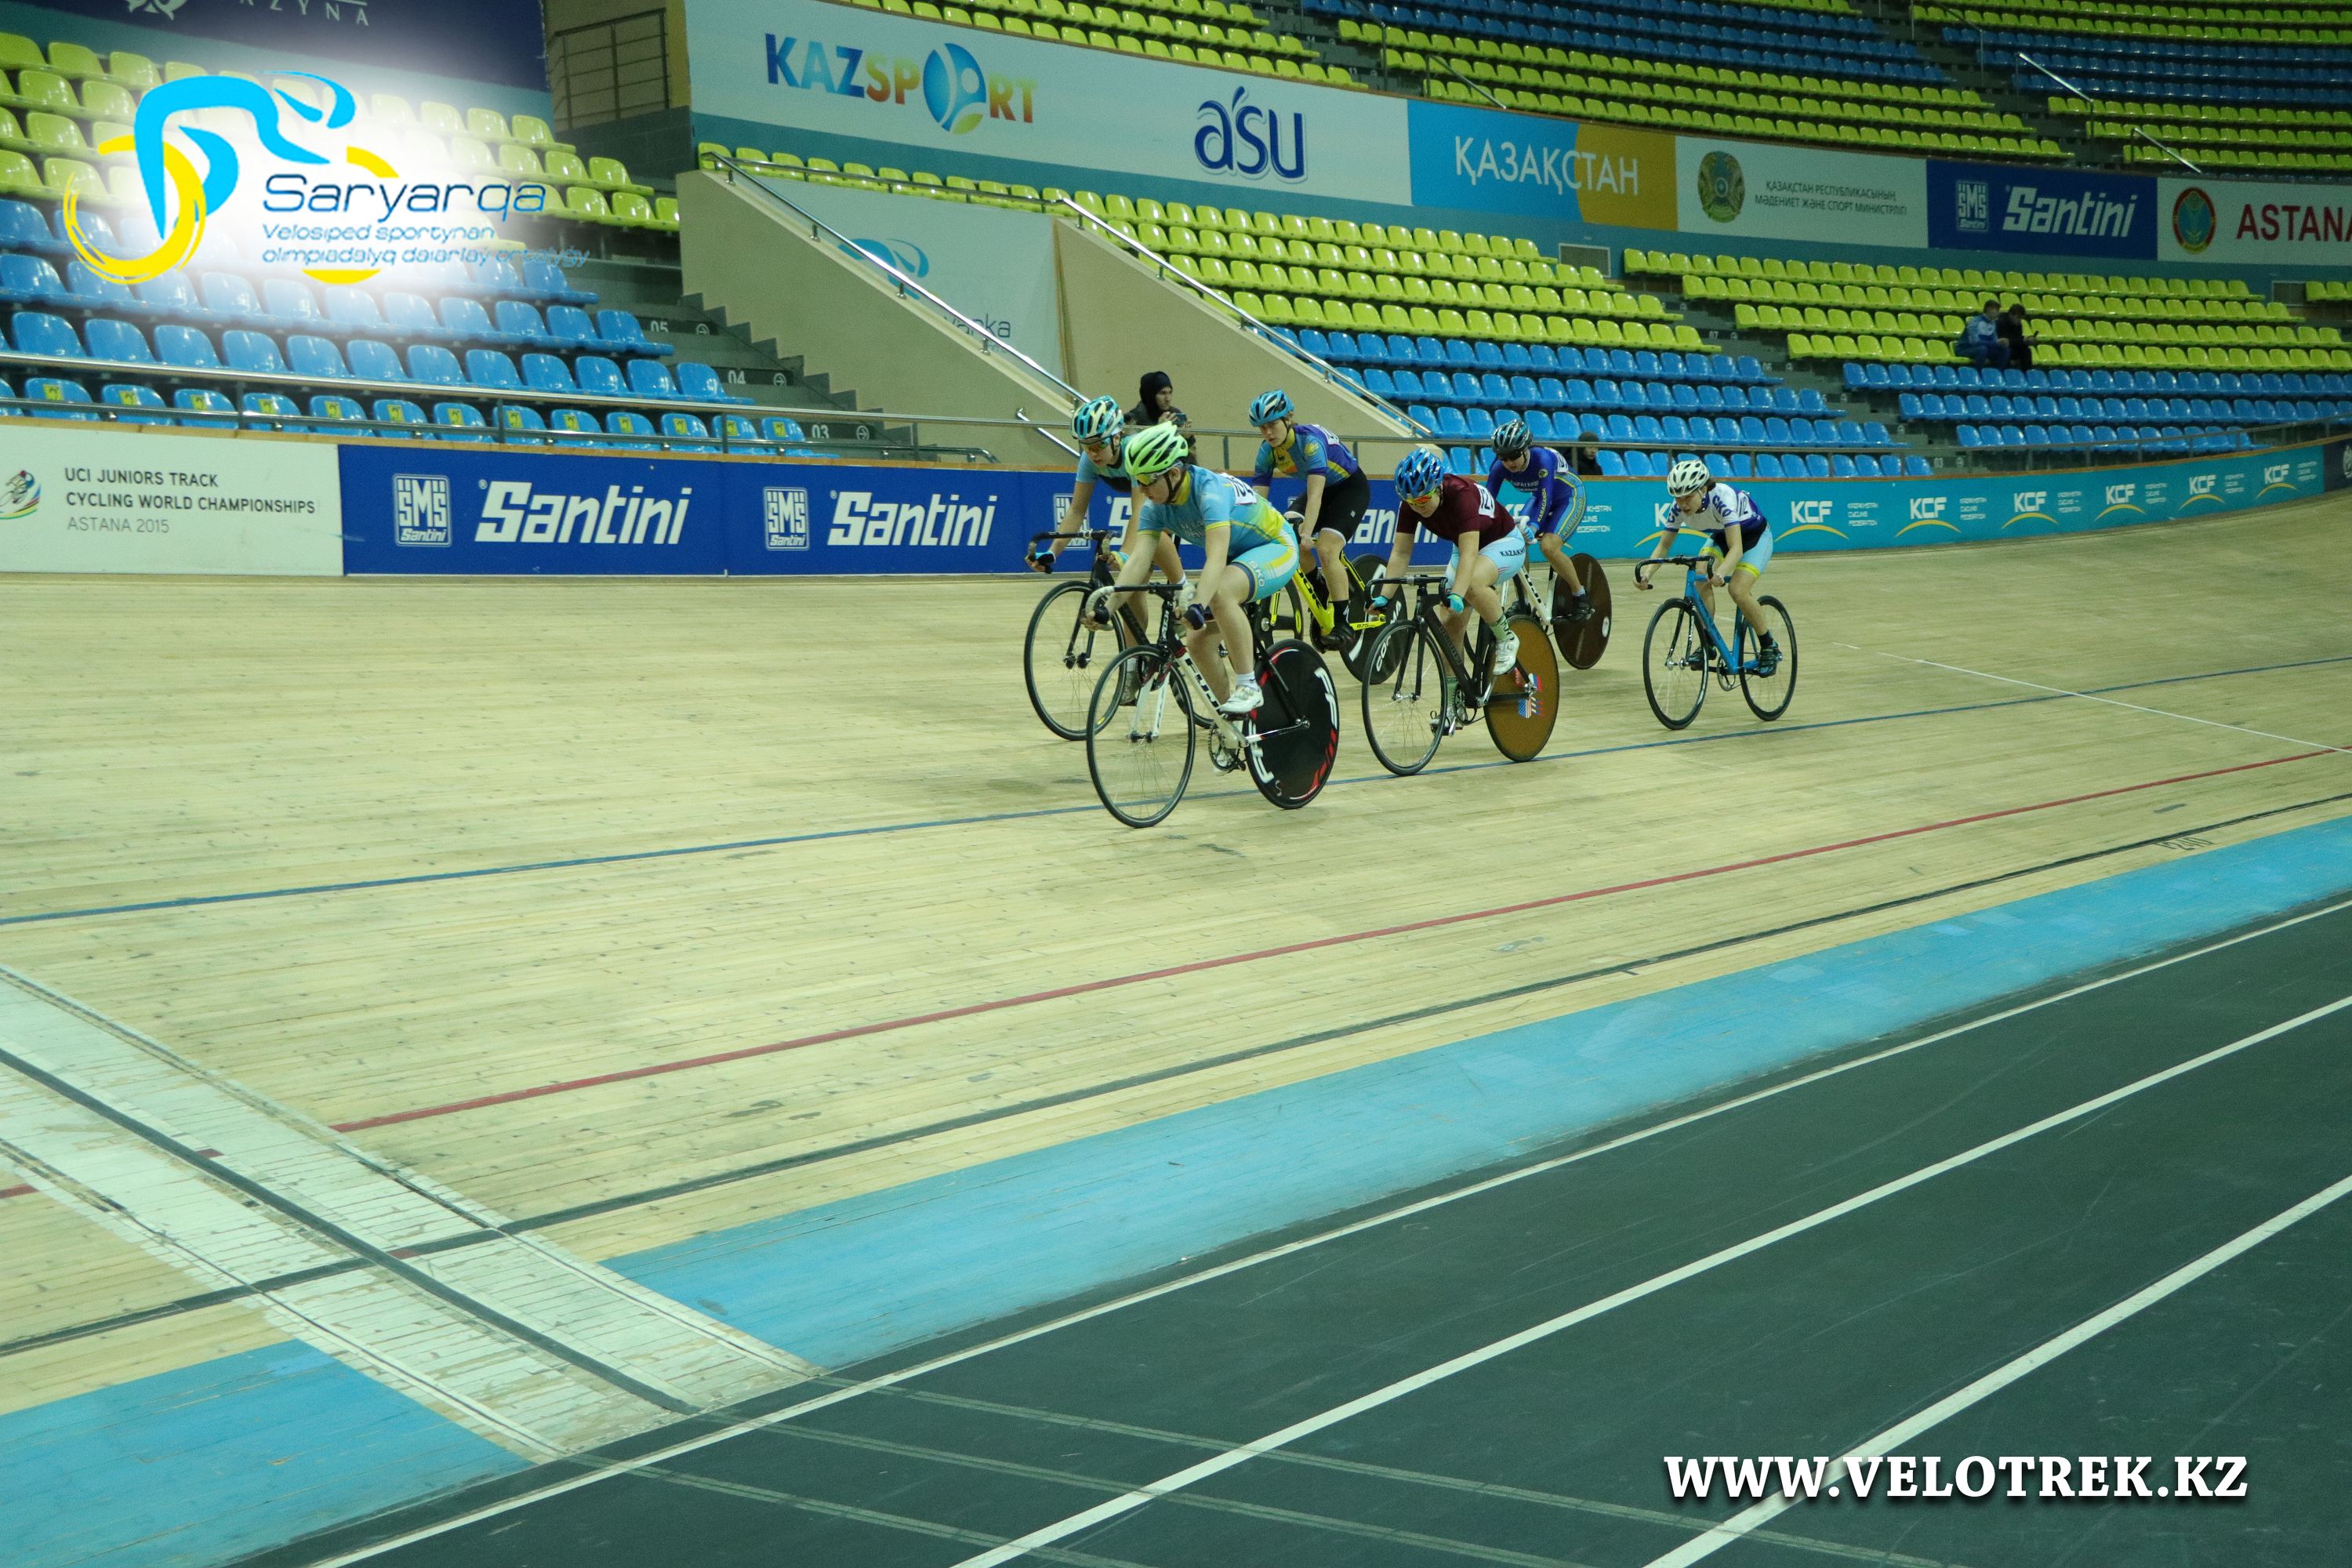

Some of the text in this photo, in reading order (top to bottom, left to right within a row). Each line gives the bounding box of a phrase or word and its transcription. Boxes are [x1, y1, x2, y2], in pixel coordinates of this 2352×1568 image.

[1455, 136, 1639, 195] ҚАЗАҚСТАН
[2002, 187, 2138, 238] Santini
[64, 468, 219, 488] UCI JUNIORS TRACK
[2189, 475, 2216, 495] KCF
[2264, 464, 2290, 484] KCF
[66, 492, 316, 514] CYCLING WORLD CHAMPIONSHIPS
[396, 479, 447, 528] SMS
[1537, 488, 1548, 523] KARAGANDA
[2013, 491, 2047, 512] KCF
[2106, 484, 2136, 505] KCF
[474, 481, 692, 545] Santini
[768, 492, 805, 534] SMS
[827, 491, 998, 546] Santini
[1791, 500, 1833, 524] KCF
[1910, 497, 1947, 519] KCF
[67, 517, 170, 534] ASTANA 2015
[401, 528, 446, 543] Santini
[770, 534, 806, 546] Santini
